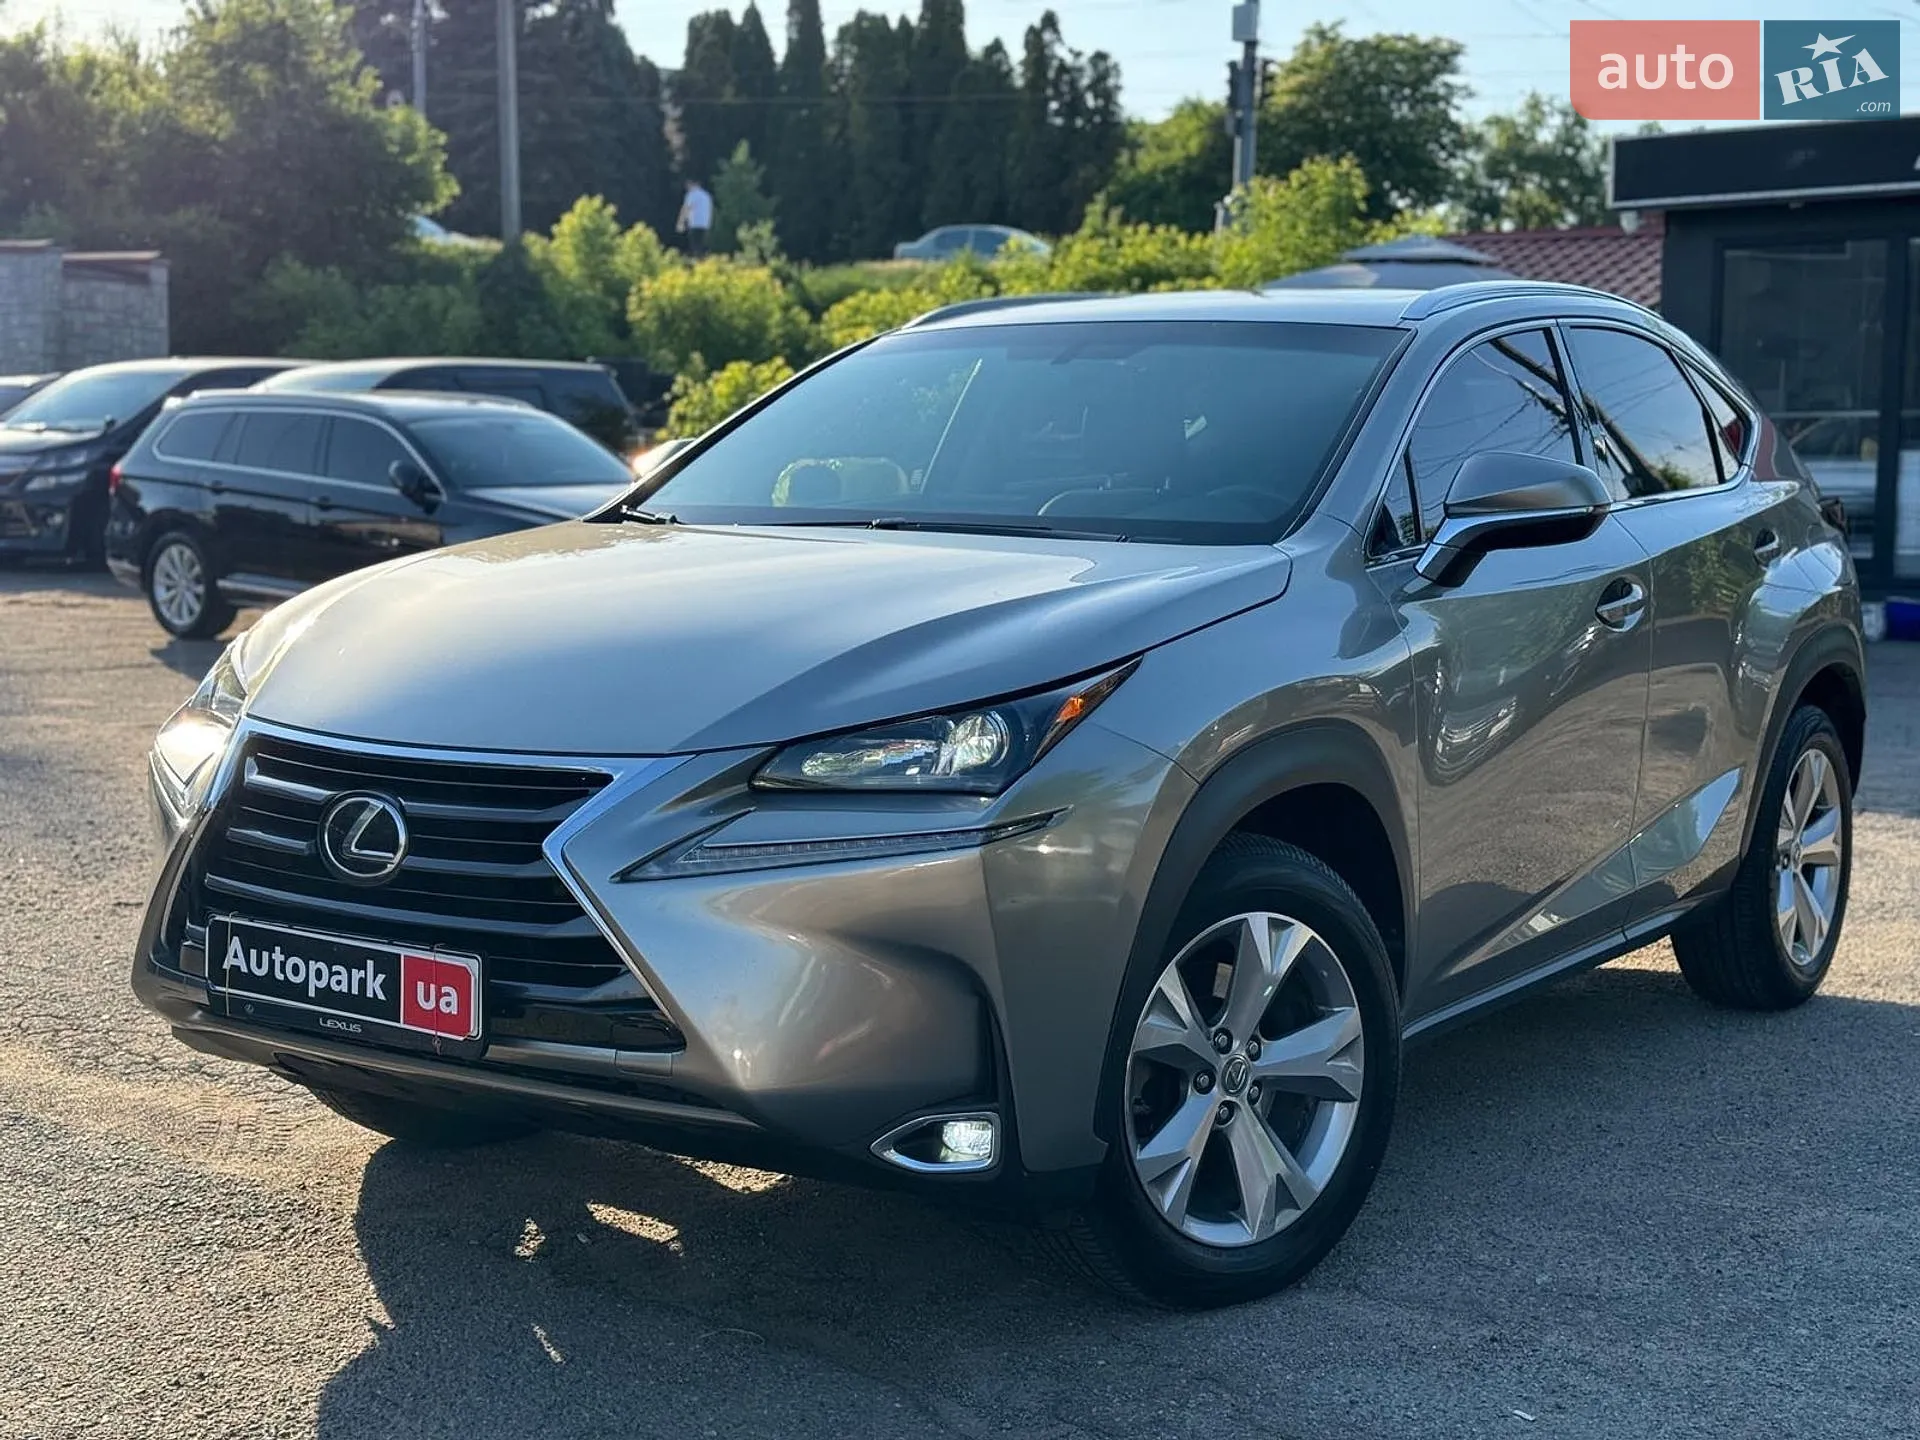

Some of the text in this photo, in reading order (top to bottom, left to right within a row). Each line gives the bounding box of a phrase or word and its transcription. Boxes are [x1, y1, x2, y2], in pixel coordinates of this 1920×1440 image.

[222, 936, 458, 1015] Autopark ua
[319, 1017, 362, 1033] LEXUS
